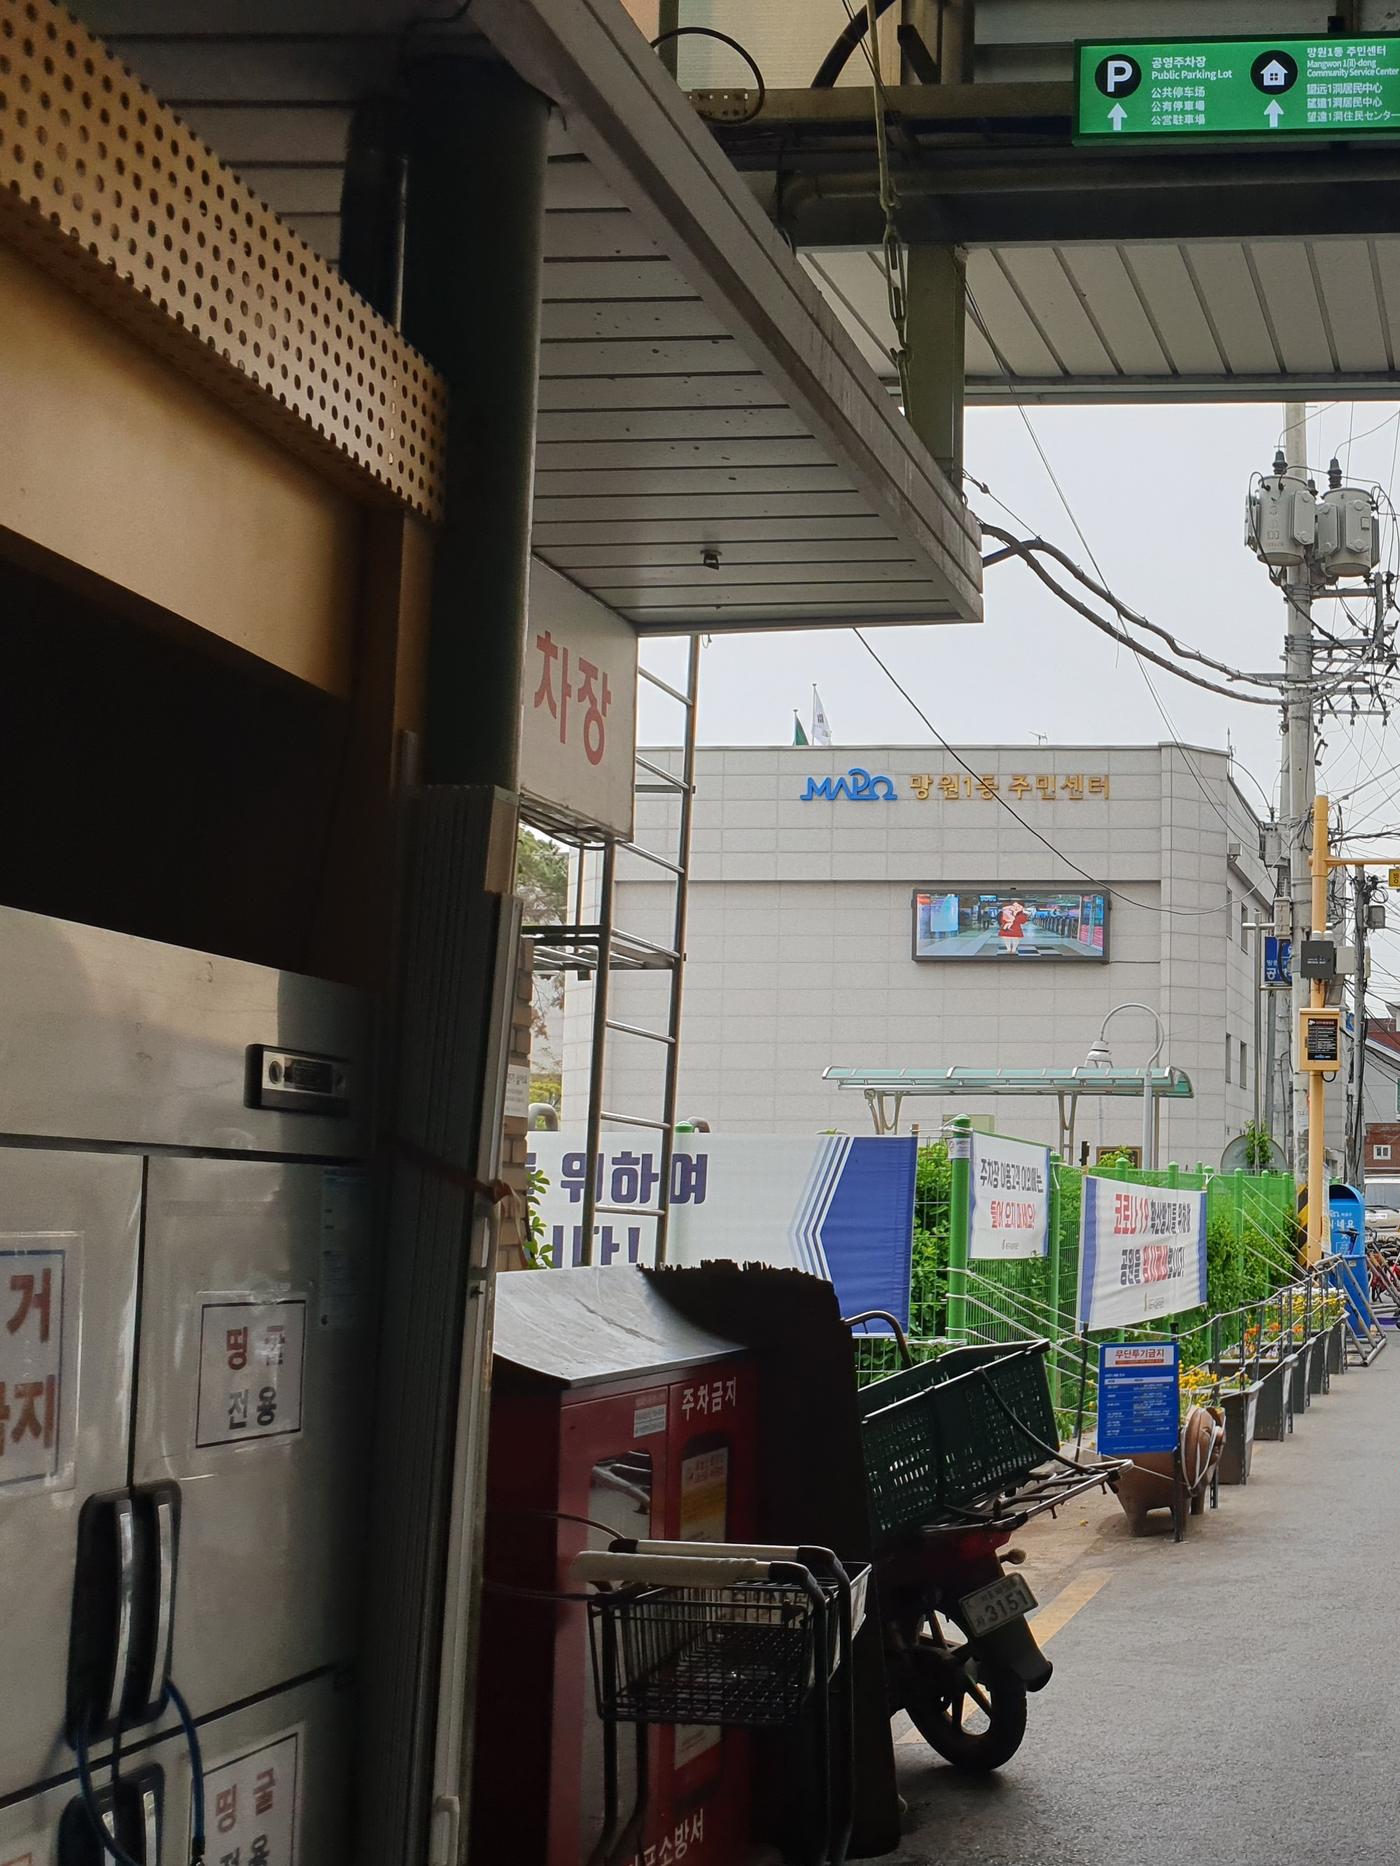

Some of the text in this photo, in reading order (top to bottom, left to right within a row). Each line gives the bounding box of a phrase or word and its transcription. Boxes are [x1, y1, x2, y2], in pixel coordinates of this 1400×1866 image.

[1306, 45, 1386, 58] 망원1동 주민센터
[1152, 56, 1206, 69] 공영주차장
[1306, 60, 1342, 70] Mangwon
[1306, 67, 1399, 78] Community Service Center
[1151, 69, 1233, 80] Public Parking Lot
[1151, 86, 1206, 98] 公共停车场
[800, 767, 898, 801] MAPO
[909, 773, 1111, 800] 망원1동 주민센터
[560, 1151, 709, 1205] 위하여
[979, 1158, 1000, 1189] 주차장
[1114, 1193, 1149, 1235] 코로나19
[1115, 1348, 1165, 1359] 무단투기금지
[681, 1376, 737, 1421] 주차금지
[984, 1589, 1029, 1621] 3151
